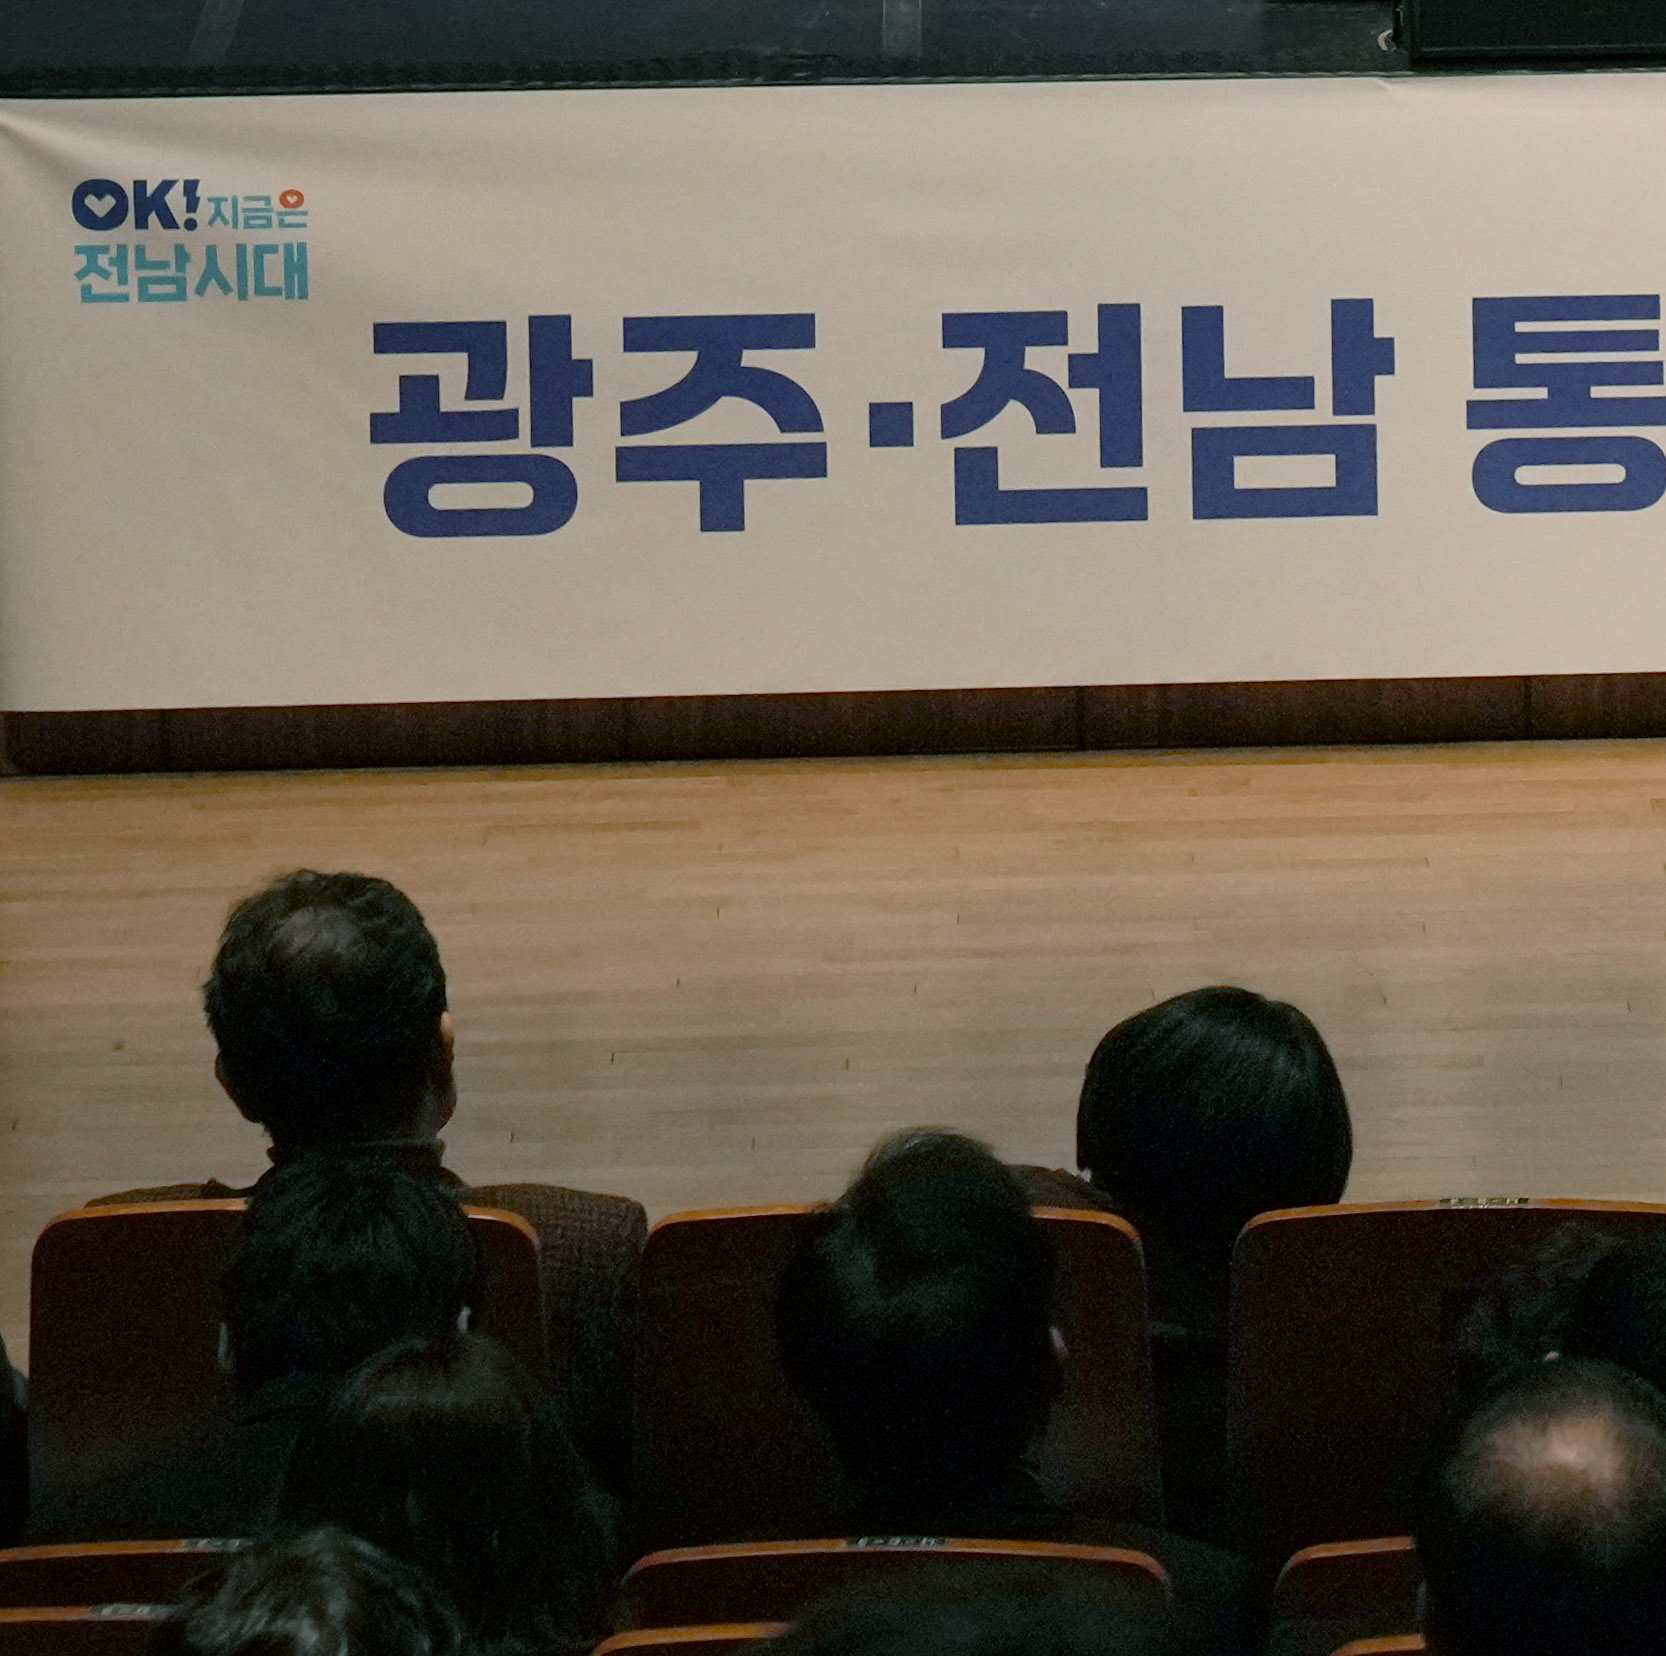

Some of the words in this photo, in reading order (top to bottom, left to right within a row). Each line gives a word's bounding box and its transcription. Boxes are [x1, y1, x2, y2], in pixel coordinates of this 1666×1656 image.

[72, 178, 201, 231] OK!
[207, 189, 309, 230] 지금은
[74, 242, 309, 304] 전남시대
[369, 297, 1396, 539] 광주·전남
